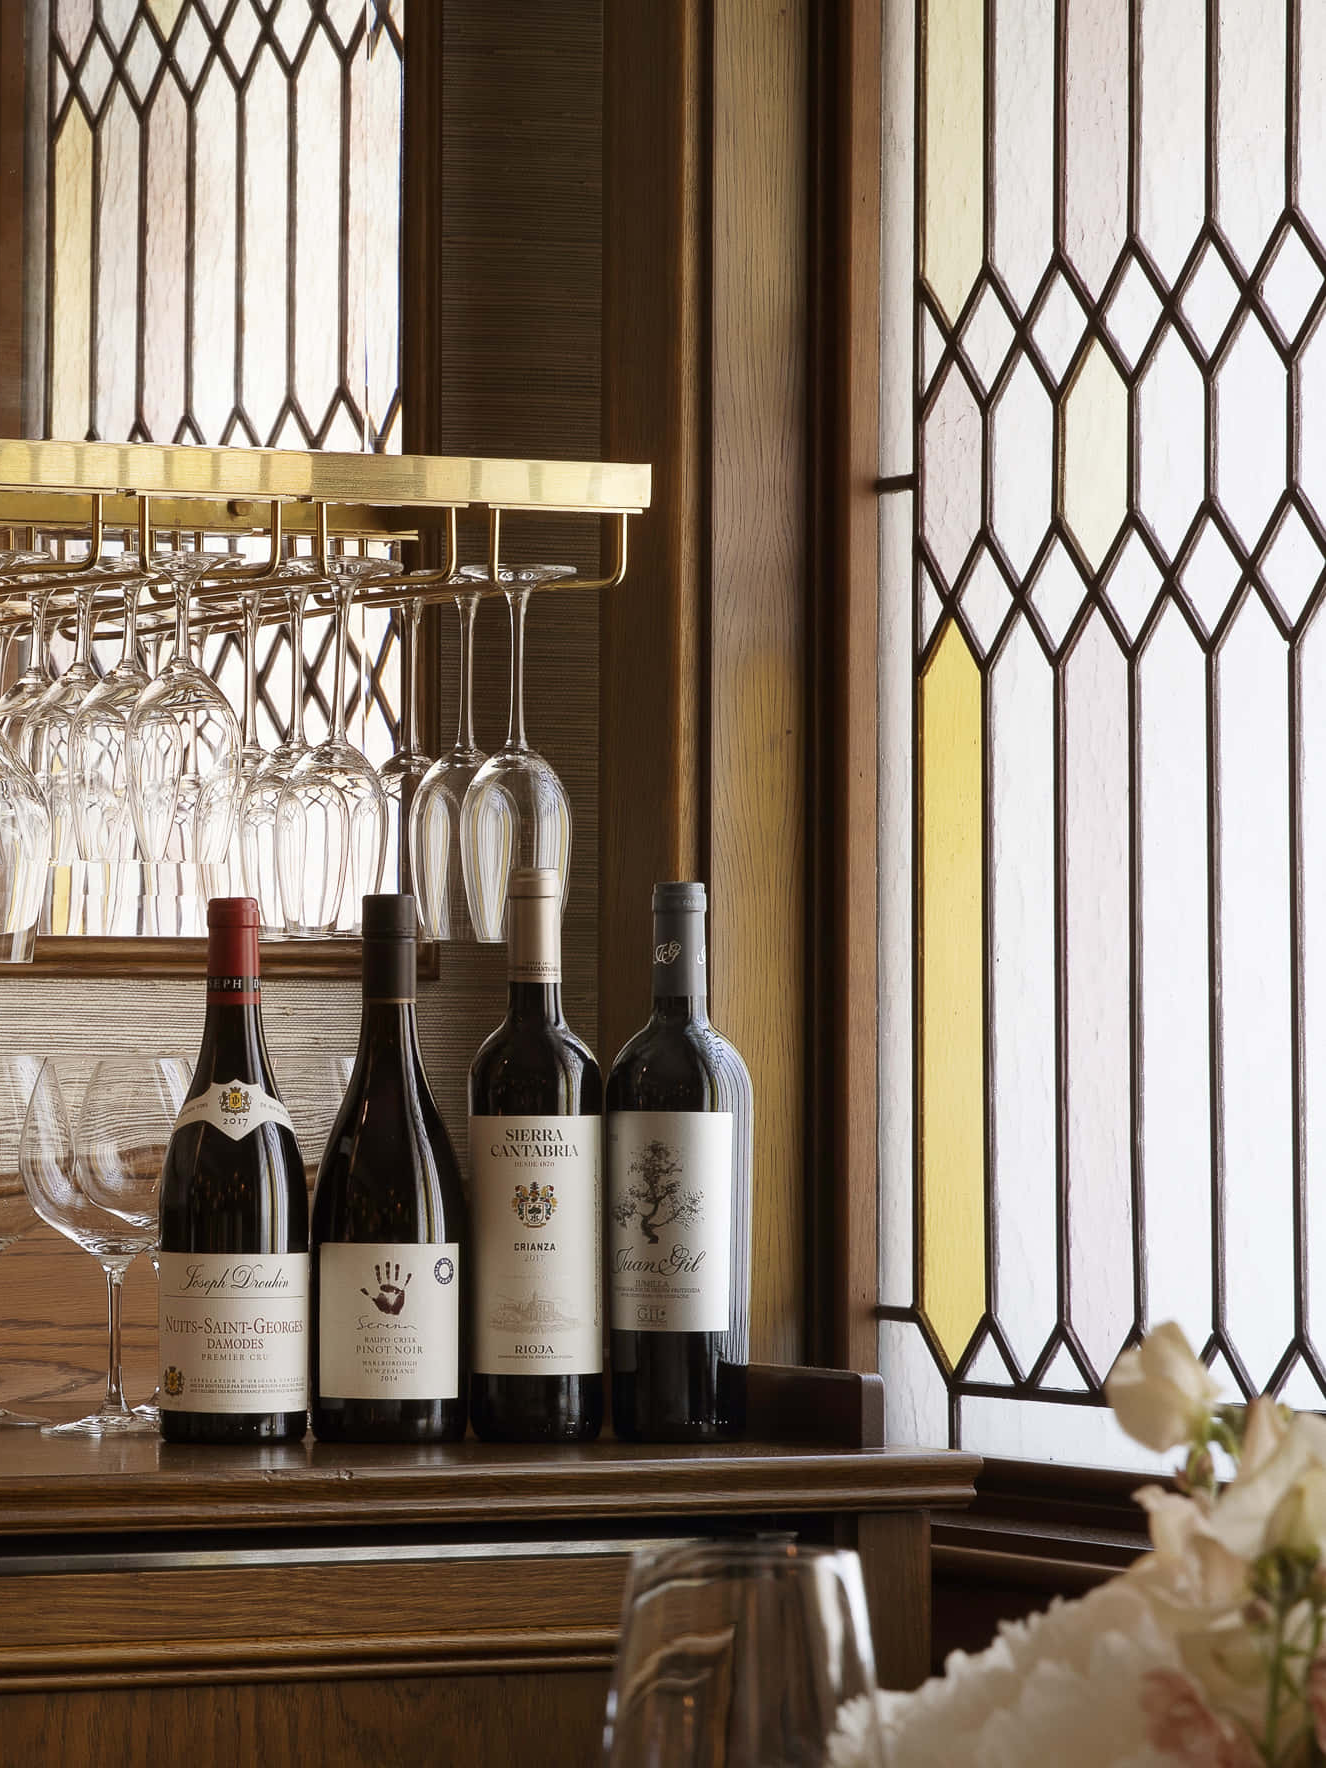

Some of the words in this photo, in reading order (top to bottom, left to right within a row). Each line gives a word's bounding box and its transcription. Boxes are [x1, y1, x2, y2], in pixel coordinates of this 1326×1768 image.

[223, 1118, 249, 1128] 2017
[505, 1128, 563, 1142] SIERRA
[490, 1144, 578, 1158] CANTABRIA
[514, 1242, 556, 1252] CRIANZA
[524, 1254, 545, 1262] 2017
[613, 1246, 659, 1274] Juan
[659, 1243, 707, 1277] Gil
[180, 1264, 230, 1296] Joseph
[231, 1264, 290, 1290] Drouhin
[164, 1315, 304, 1335] NUITS-SAINT-GEORGES
[207, 1338, 264, 1350] DAMODES
[514, 1344, 555, 1354] RIOJA
[356, 1345, 391, 1355] PINOT
[394, 1345, 424, 1355] NOIR
[201, 1353, 246, 1361] PREMIER
[249, 1353, 269, 1361] CRU
